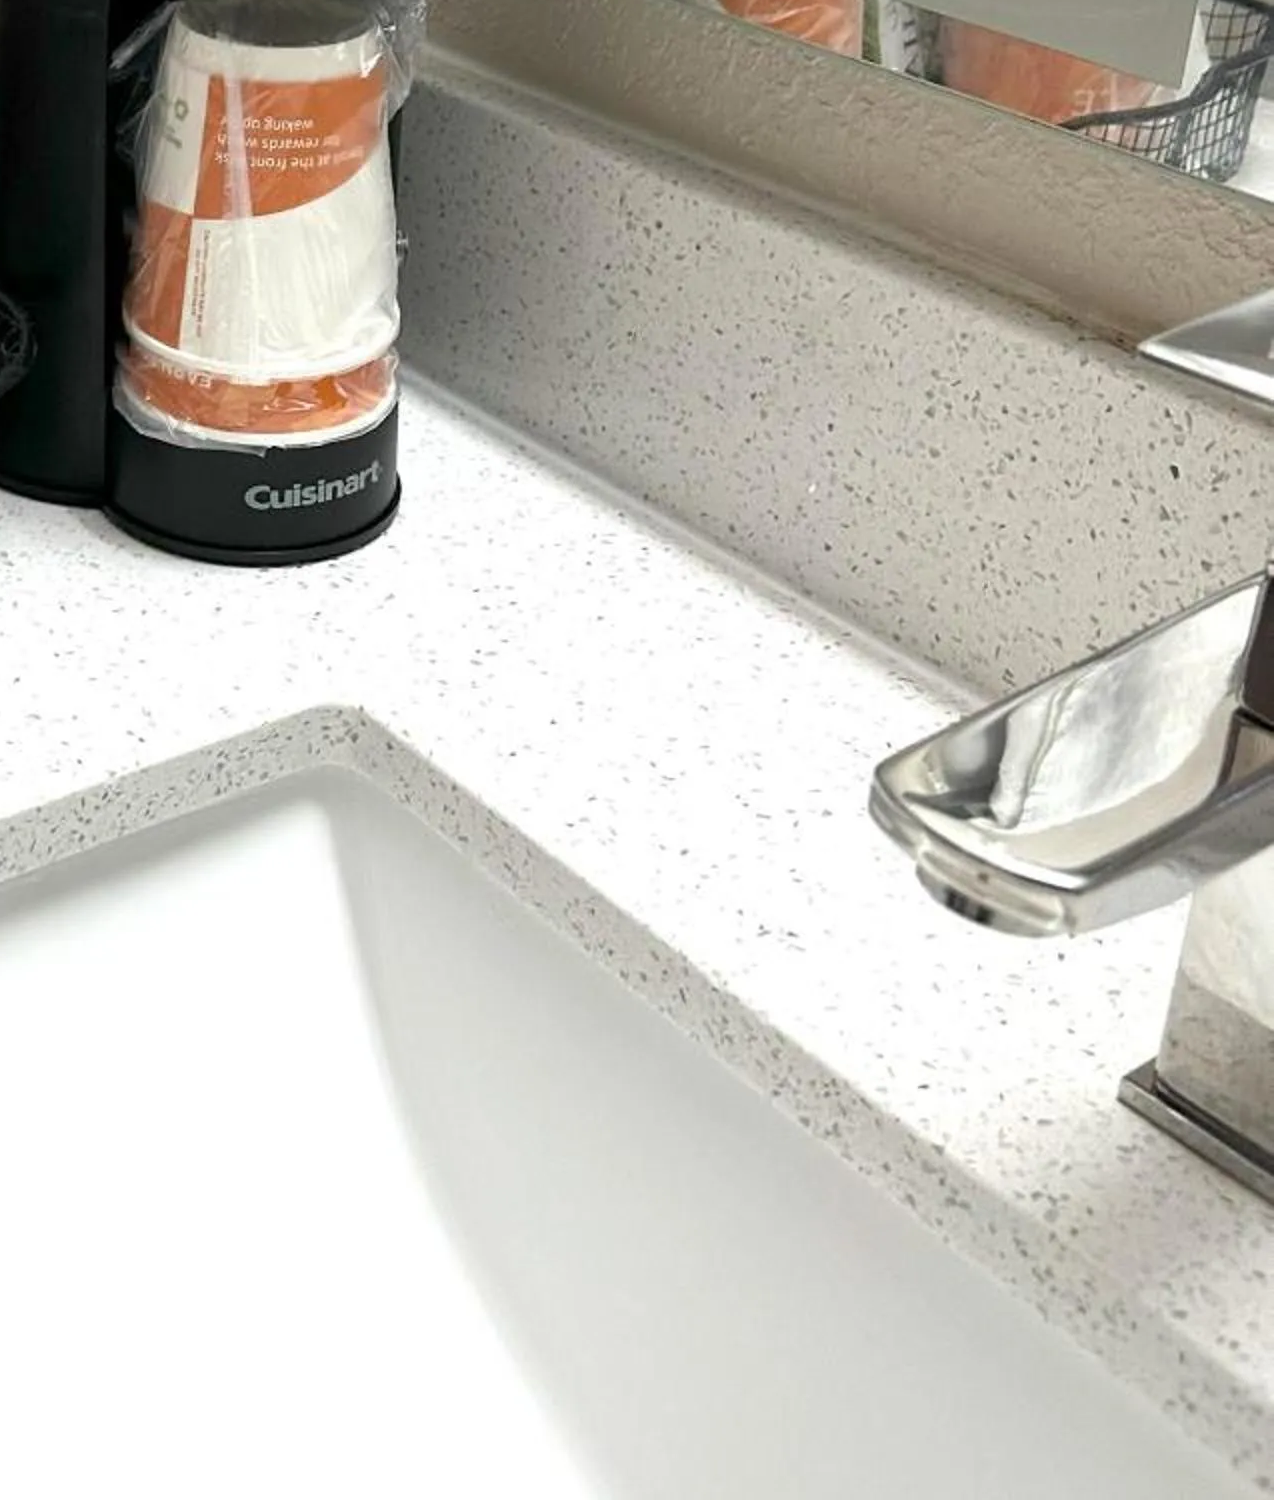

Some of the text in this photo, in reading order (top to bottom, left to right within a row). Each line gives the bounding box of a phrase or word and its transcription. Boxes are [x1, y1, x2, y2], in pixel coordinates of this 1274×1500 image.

[264, 115, 314, 133] waking
[261, 137, 319, 152] rewards
[249, 155, 287, 171] front
[290, 157, 314, 171] the
[244, 459, 381, 510] Cuisinart
